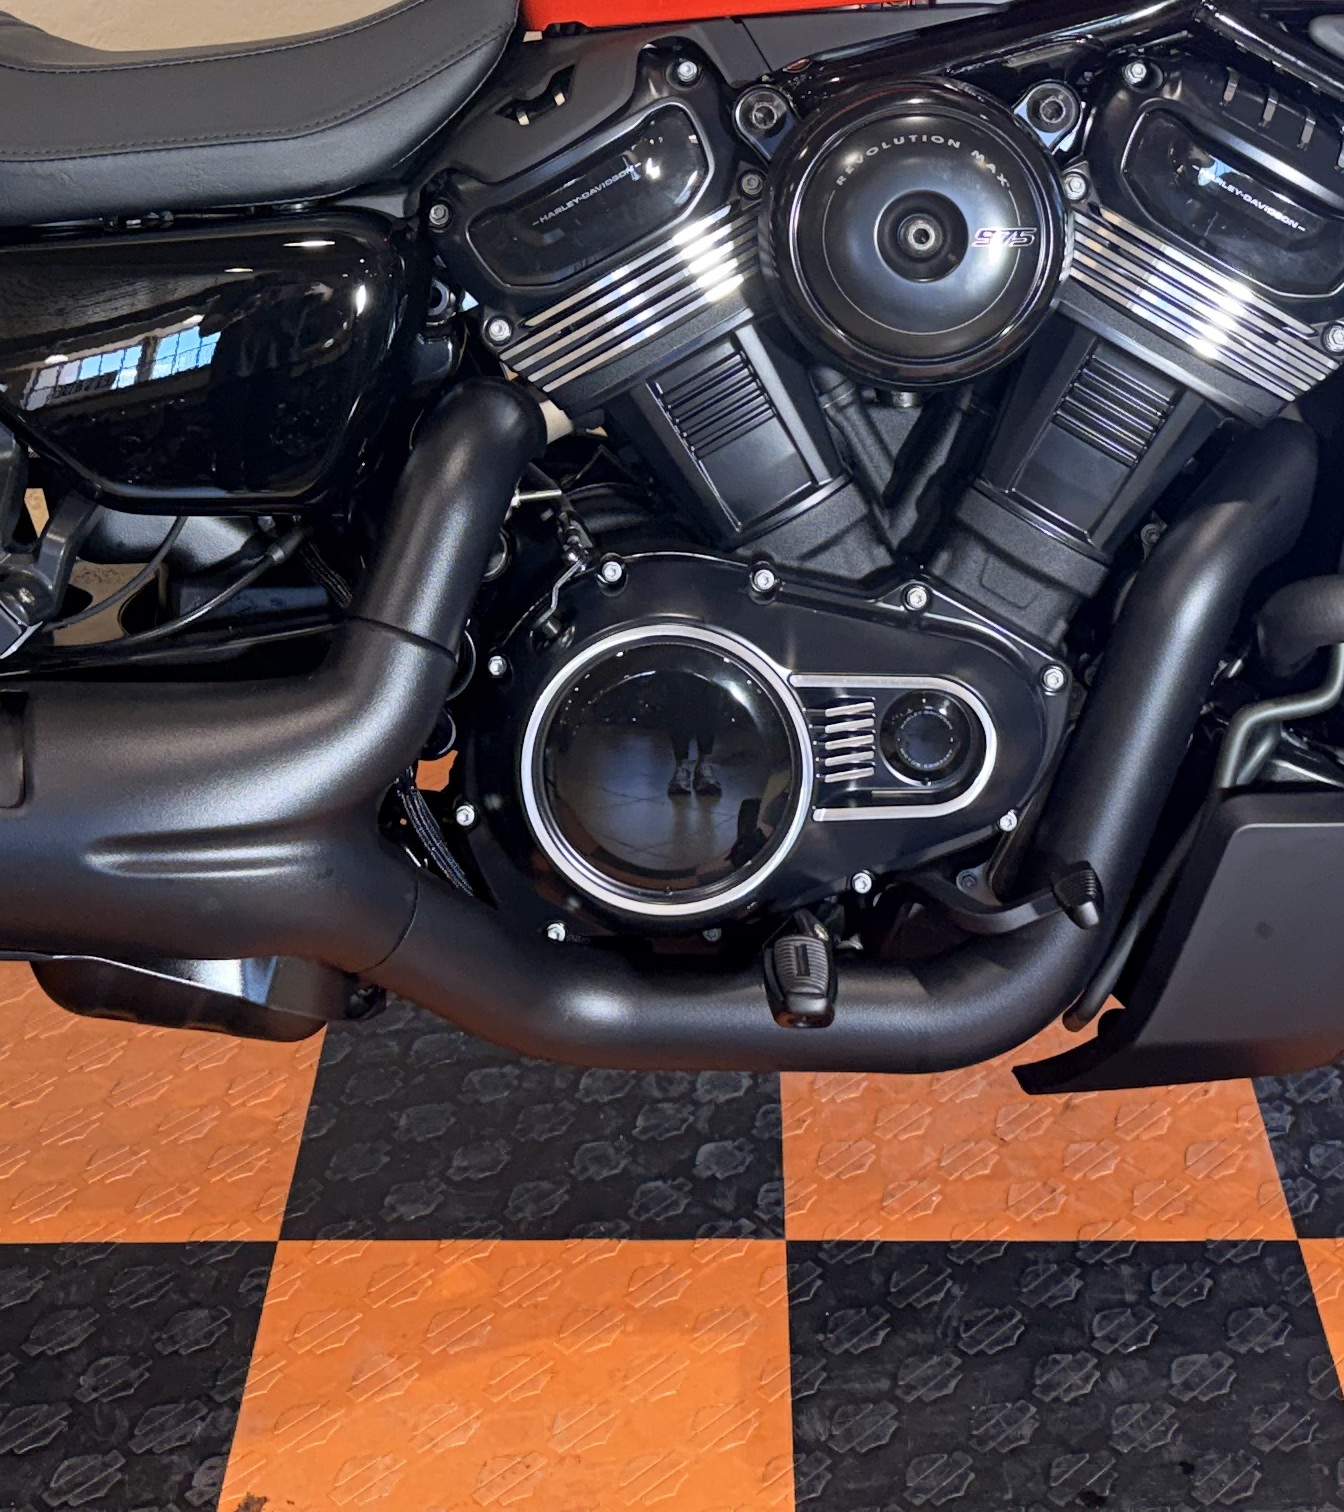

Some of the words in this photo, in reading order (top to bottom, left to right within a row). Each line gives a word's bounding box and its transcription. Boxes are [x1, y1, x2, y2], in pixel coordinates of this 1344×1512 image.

[835, 134, 961, 187] REVOLUTION
[970, 149, 1007, 188] MAX
[971, 226, 1038, 248] 975
